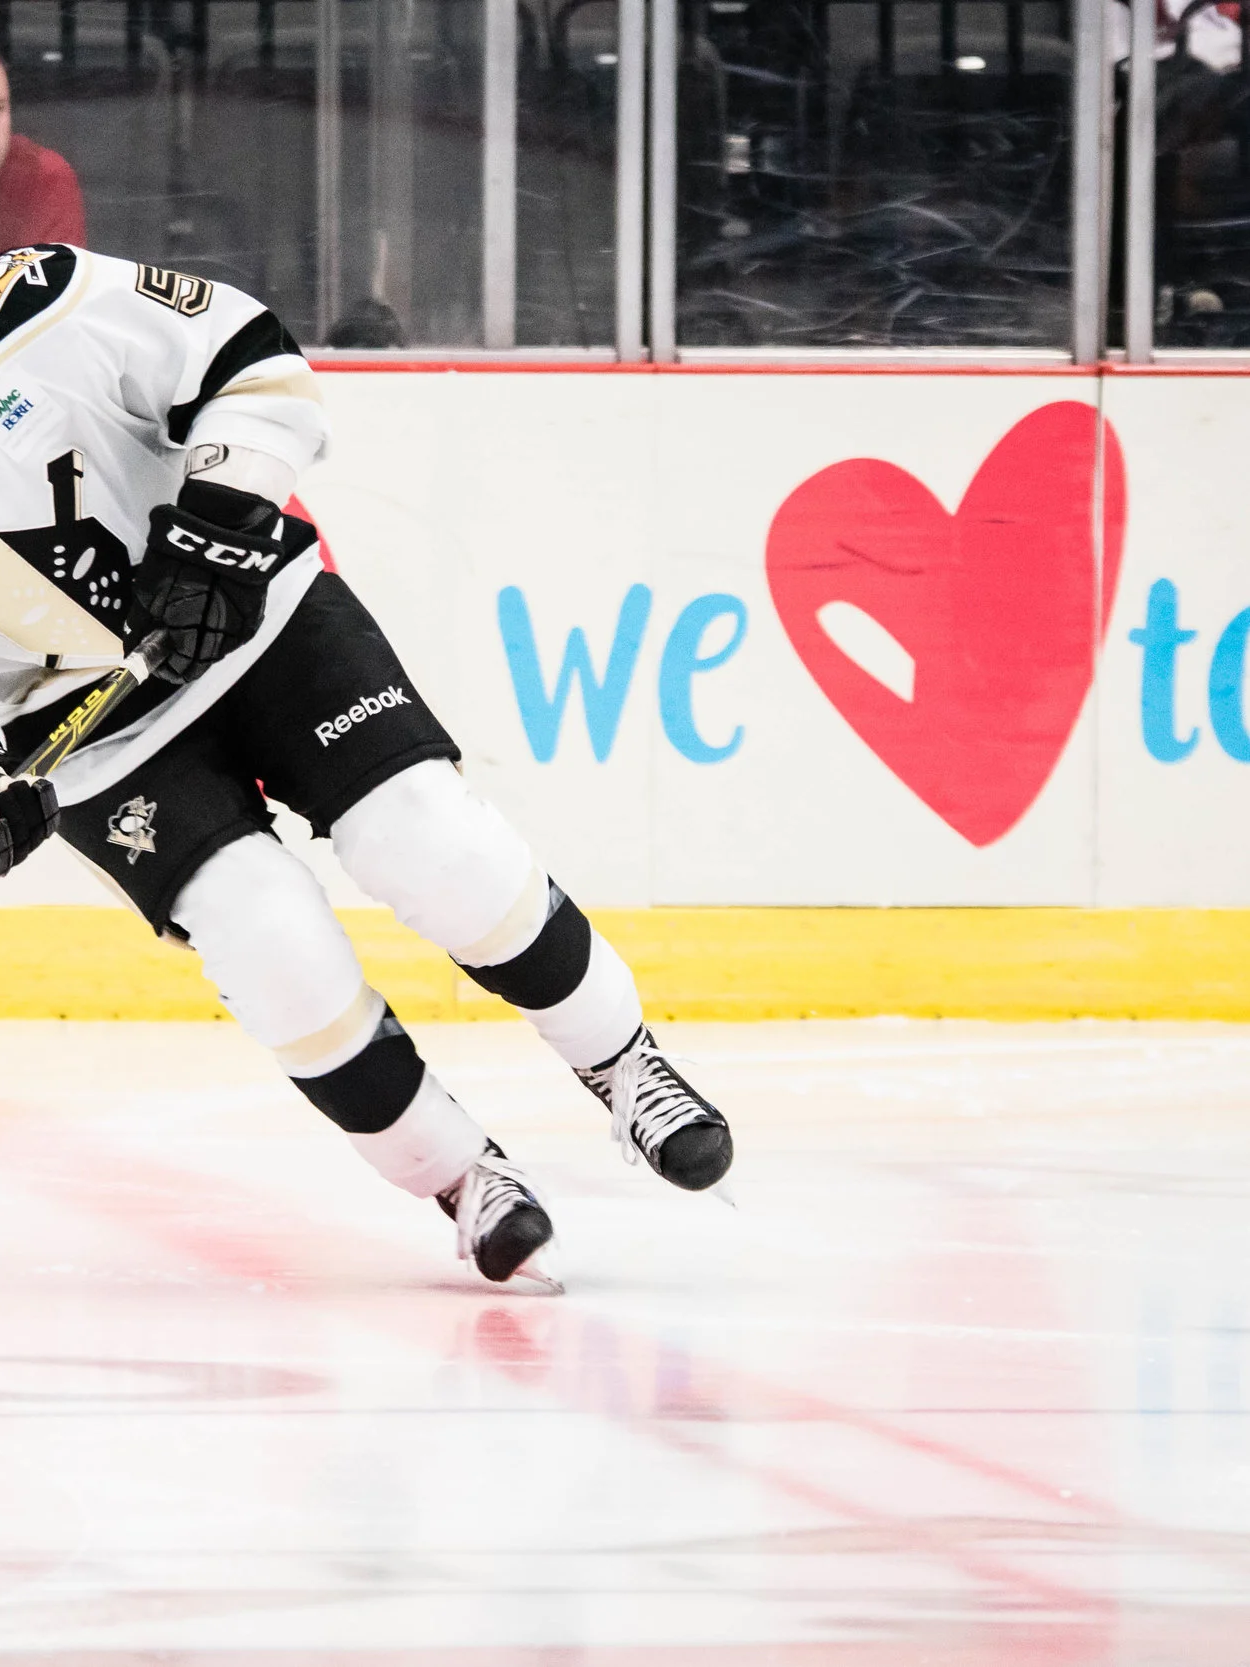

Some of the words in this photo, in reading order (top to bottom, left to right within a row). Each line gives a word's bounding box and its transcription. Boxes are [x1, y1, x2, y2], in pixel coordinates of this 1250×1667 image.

[165, 523, 280, 573] CCM
[497, 582, 748, 765] we
[314, 684, 412, 748] Reebok
